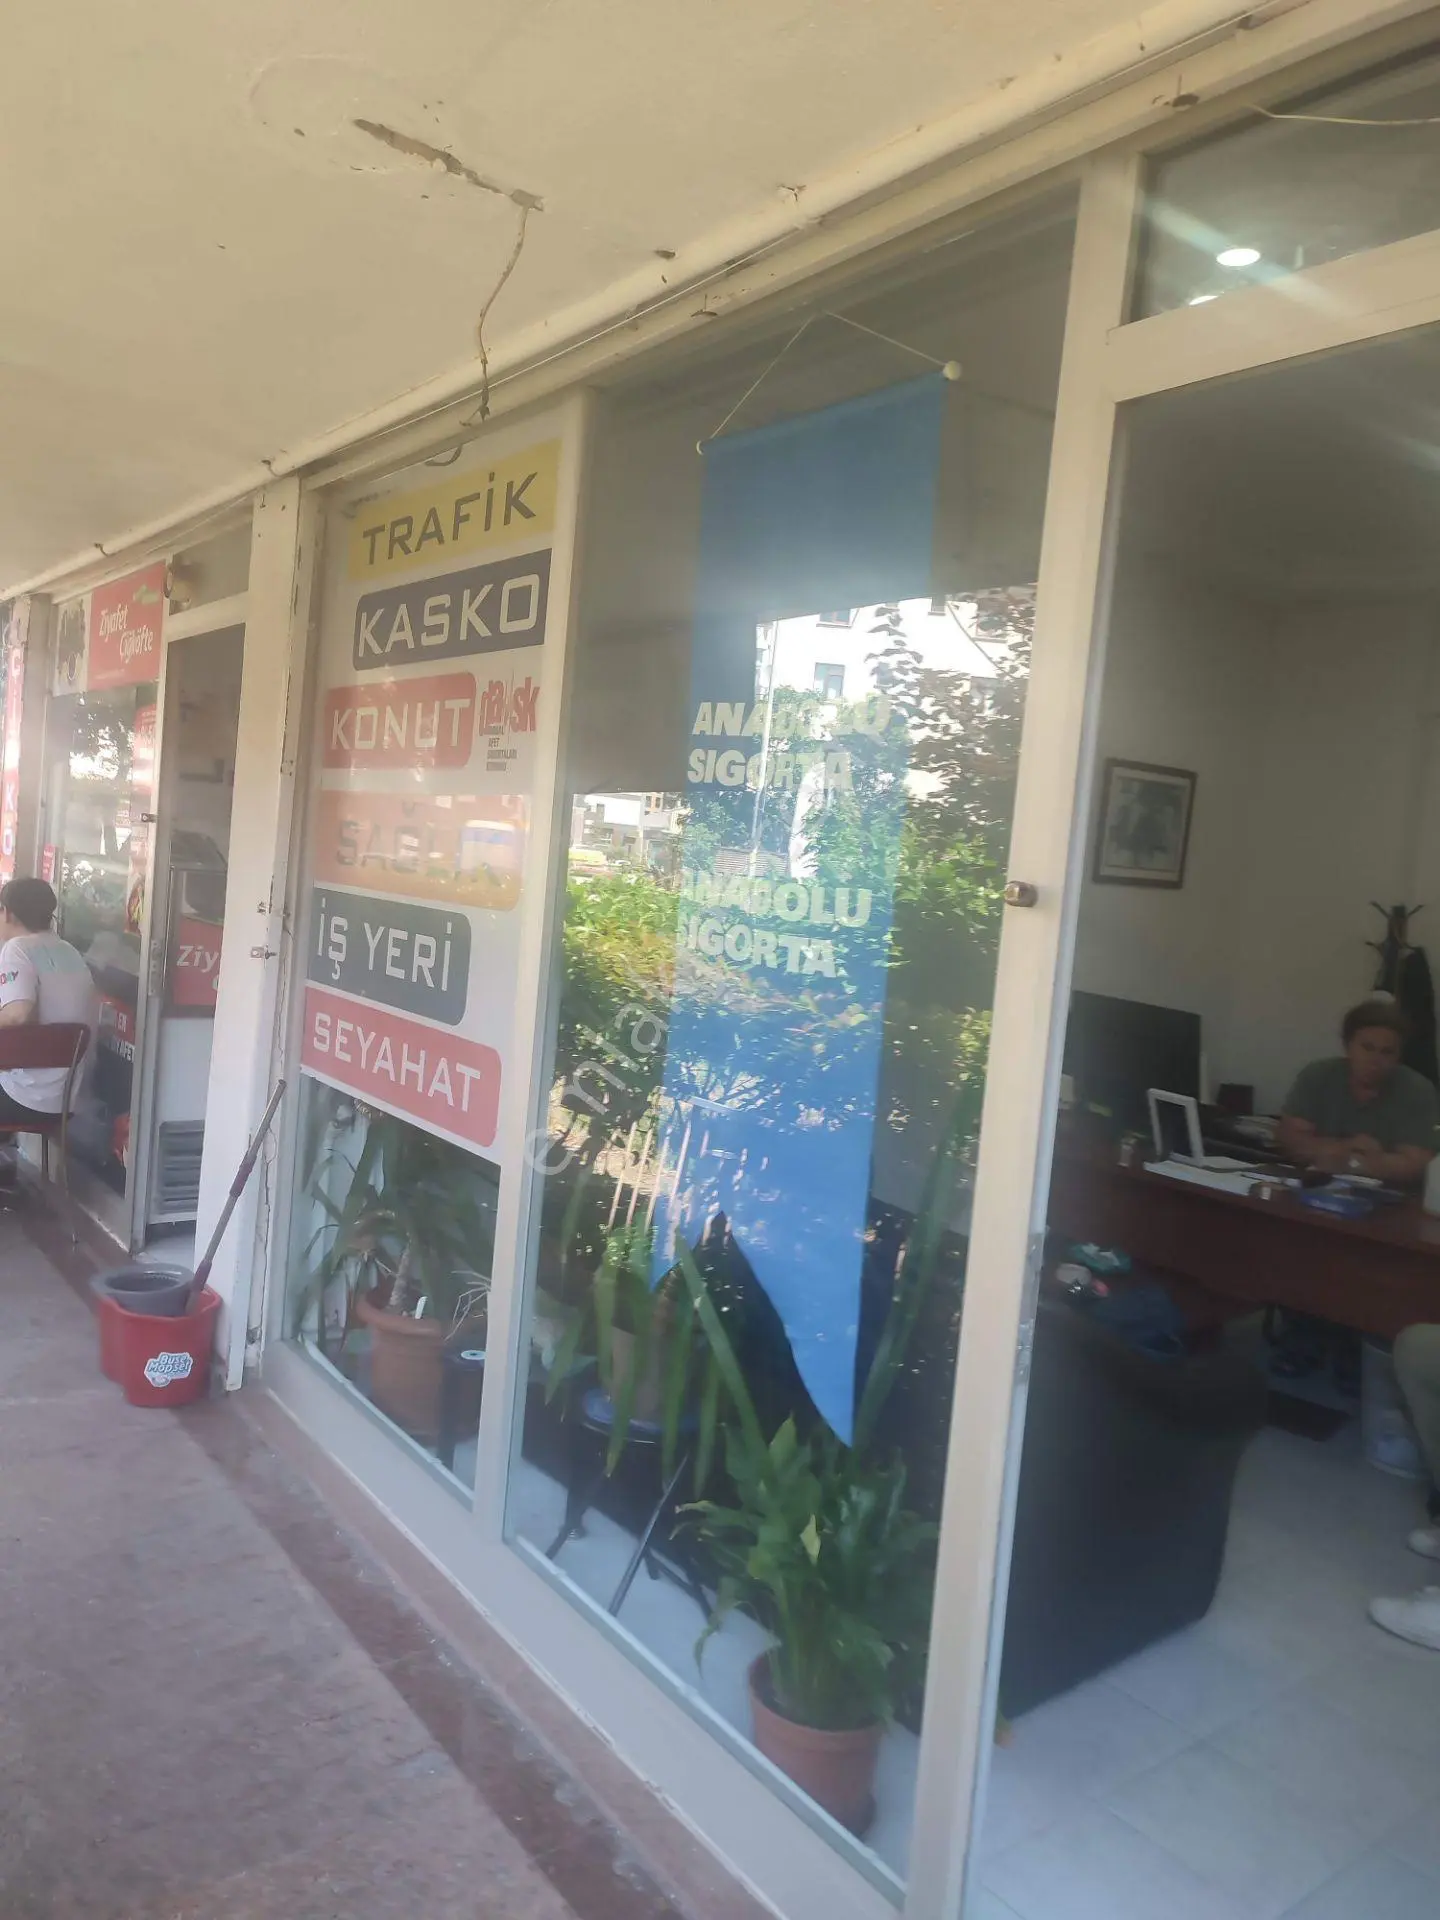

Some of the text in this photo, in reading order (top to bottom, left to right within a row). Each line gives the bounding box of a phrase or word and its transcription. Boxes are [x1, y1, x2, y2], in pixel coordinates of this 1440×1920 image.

[363, 472, 537, 565] TRAFİK
[358, 574, 540, 657] KASKO
[331, 699, 471, 750] KONUT
[687, 749, 853, 788] SIGORTA
[176, 945, 219, 973] Ziy
[317, 897, 452, 992] İŞ YERİ
[313, 1012, 481, 1112] SEYAHAT
